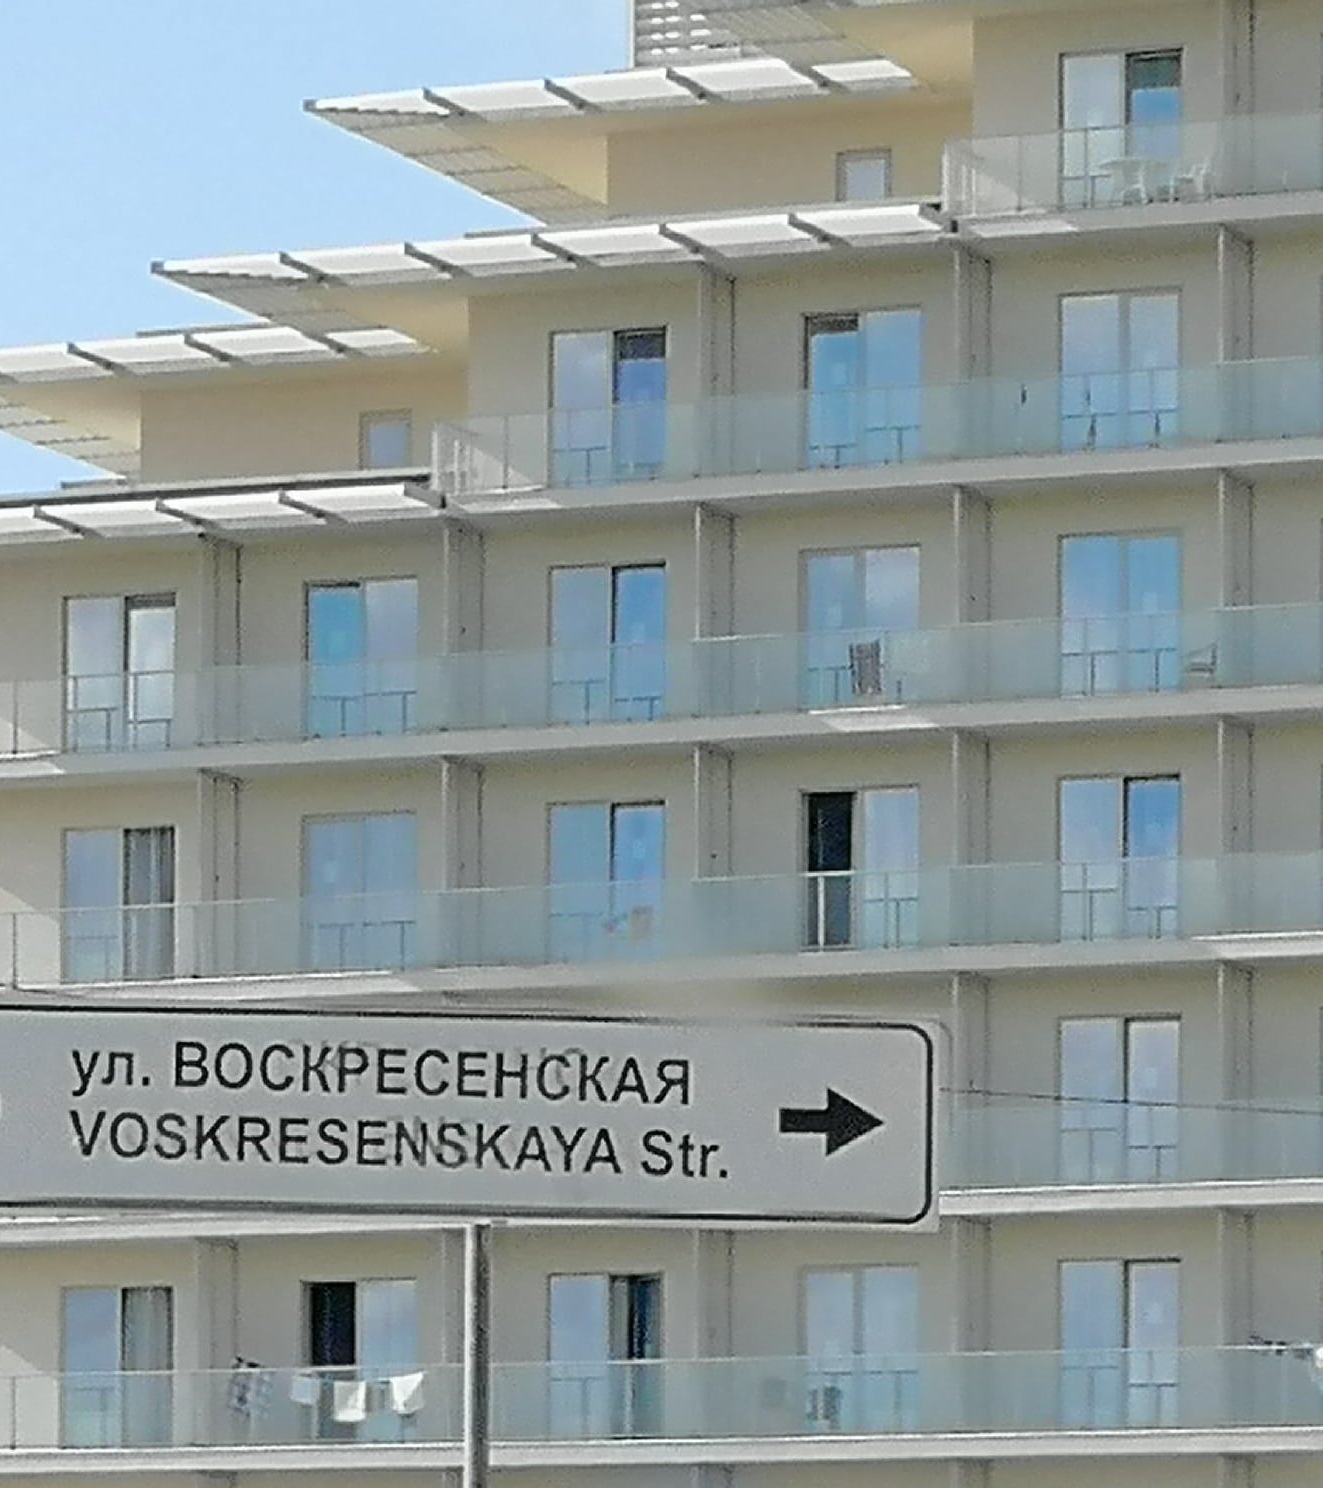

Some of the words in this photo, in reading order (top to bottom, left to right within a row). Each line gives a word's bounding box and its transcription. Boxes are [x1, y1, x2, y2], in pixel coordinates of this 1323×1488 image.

[71, 1049, 151, 1098] ул.
[174, 1041, 690, 1105] ВОСКРЕСЕНСКАЯ
[69, 1110, 622, 1174] VOSKRESENSKAYA
[641, 1129, 729, 1179] Str.
